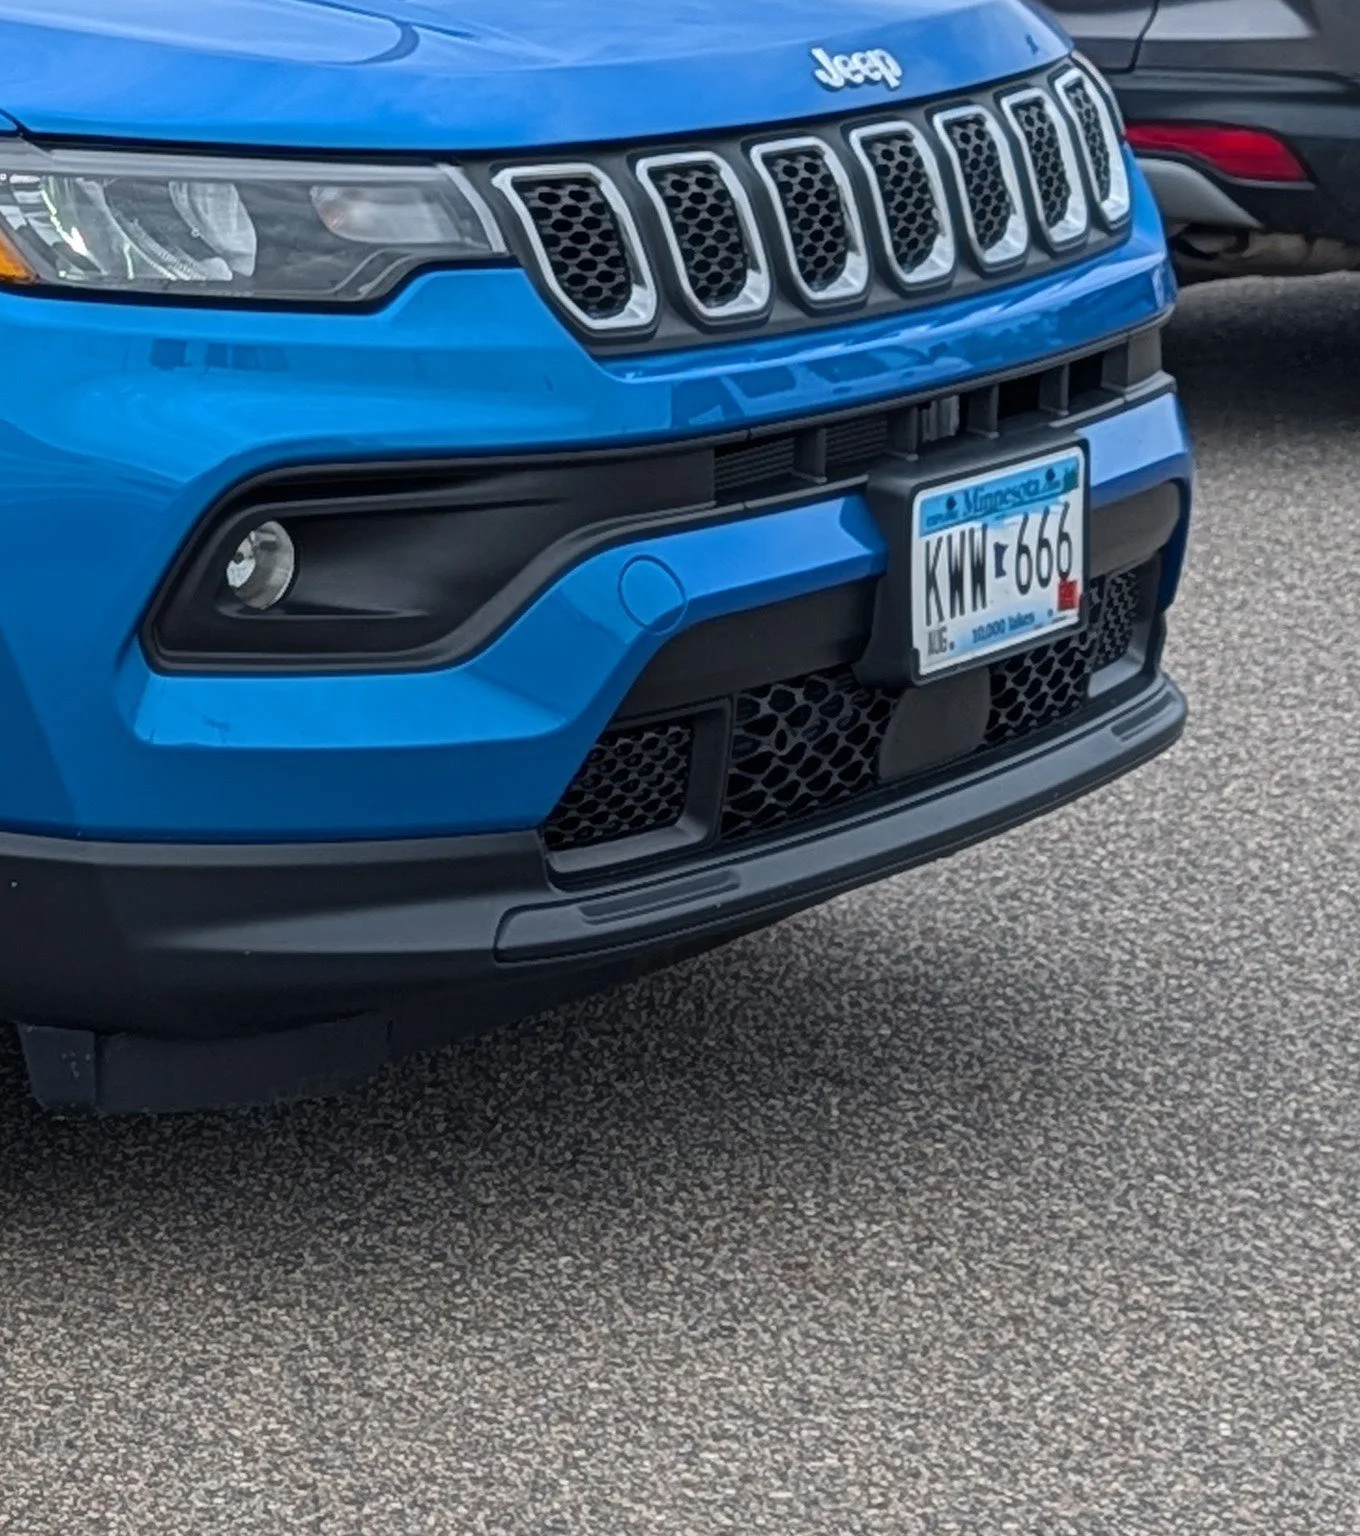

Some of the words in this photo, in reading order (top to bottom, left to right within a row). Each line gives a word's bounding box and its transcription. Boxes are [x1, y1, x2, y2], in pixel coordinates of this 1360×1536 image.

[811, 47, 902, 88] Jeep
[925, 523, 988, 627] KWW
[1015, 500, 1073, 595] 666
